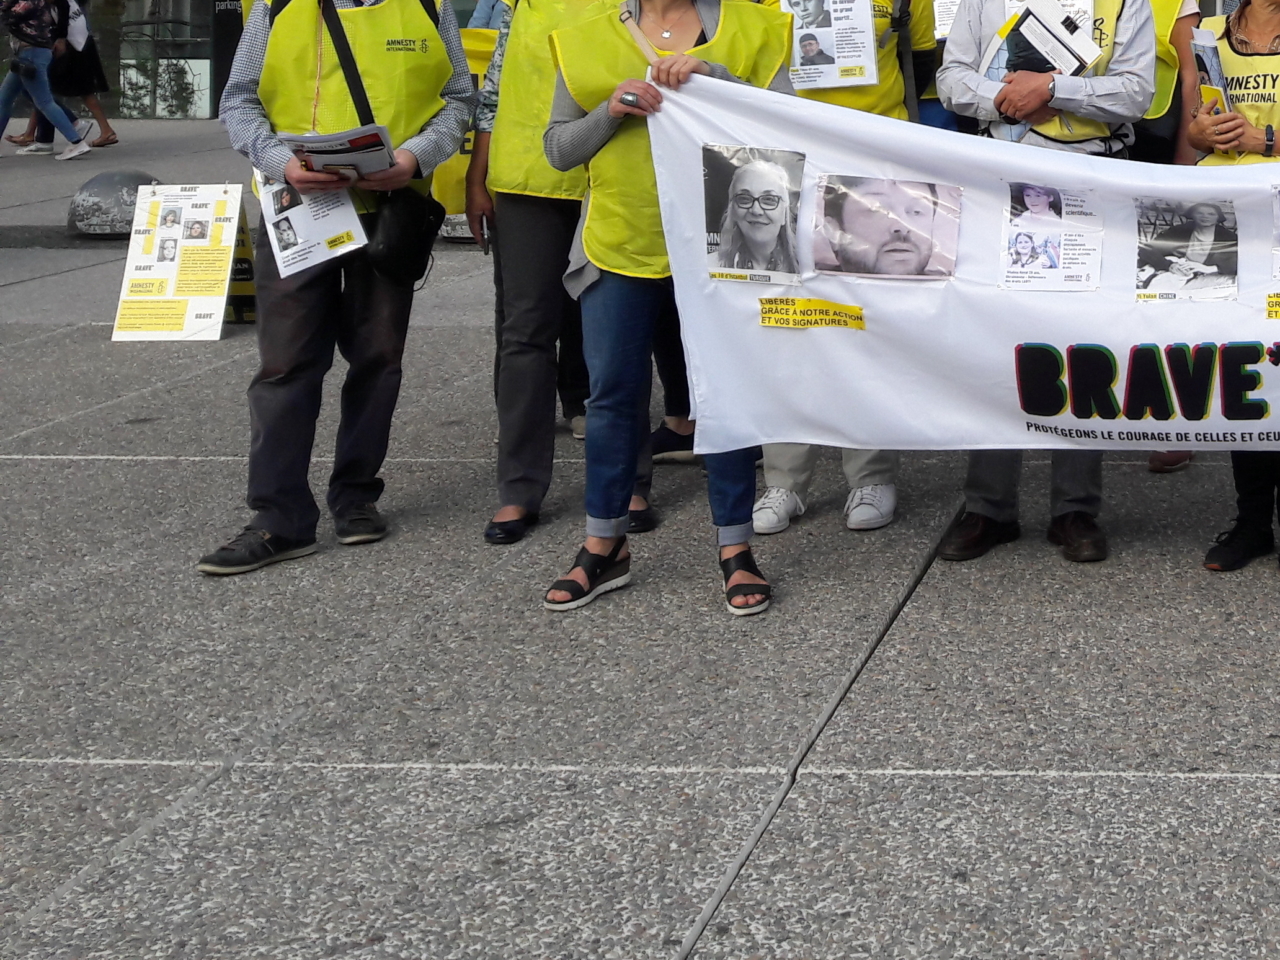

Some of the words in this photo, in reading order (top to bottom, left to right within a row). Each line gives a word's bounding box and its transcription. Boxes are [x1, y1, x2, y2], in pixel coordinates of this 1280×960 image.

[386, 39, 416, 47] AMNESTY
[1225, 73, 1280, 91] MNESTY
[1230, 92, 1277, 105] RNATIONAL
[761, 305, 790, 316] GRÂCE
[799, 308, 831, 317] NOTRE
[832, 310, 863, 322] ACTION
[1267, 310, 1280, 318] ET
[761, 317, 772, 325] ET
[774, 317, 790, 326] VOS
[792, 318, 848, 327] SIGNATURES
[1026, 421, 1098, 440] PROTÉGEONS
[1101, 430, 1114, 440] LE
[1118, 431, 1172, 442] COURAGE
[1175, 431, 1190, 442] DE
[1194, 431, 1237, 442] CELLES
[1240, 431, 1254, 442] ET
